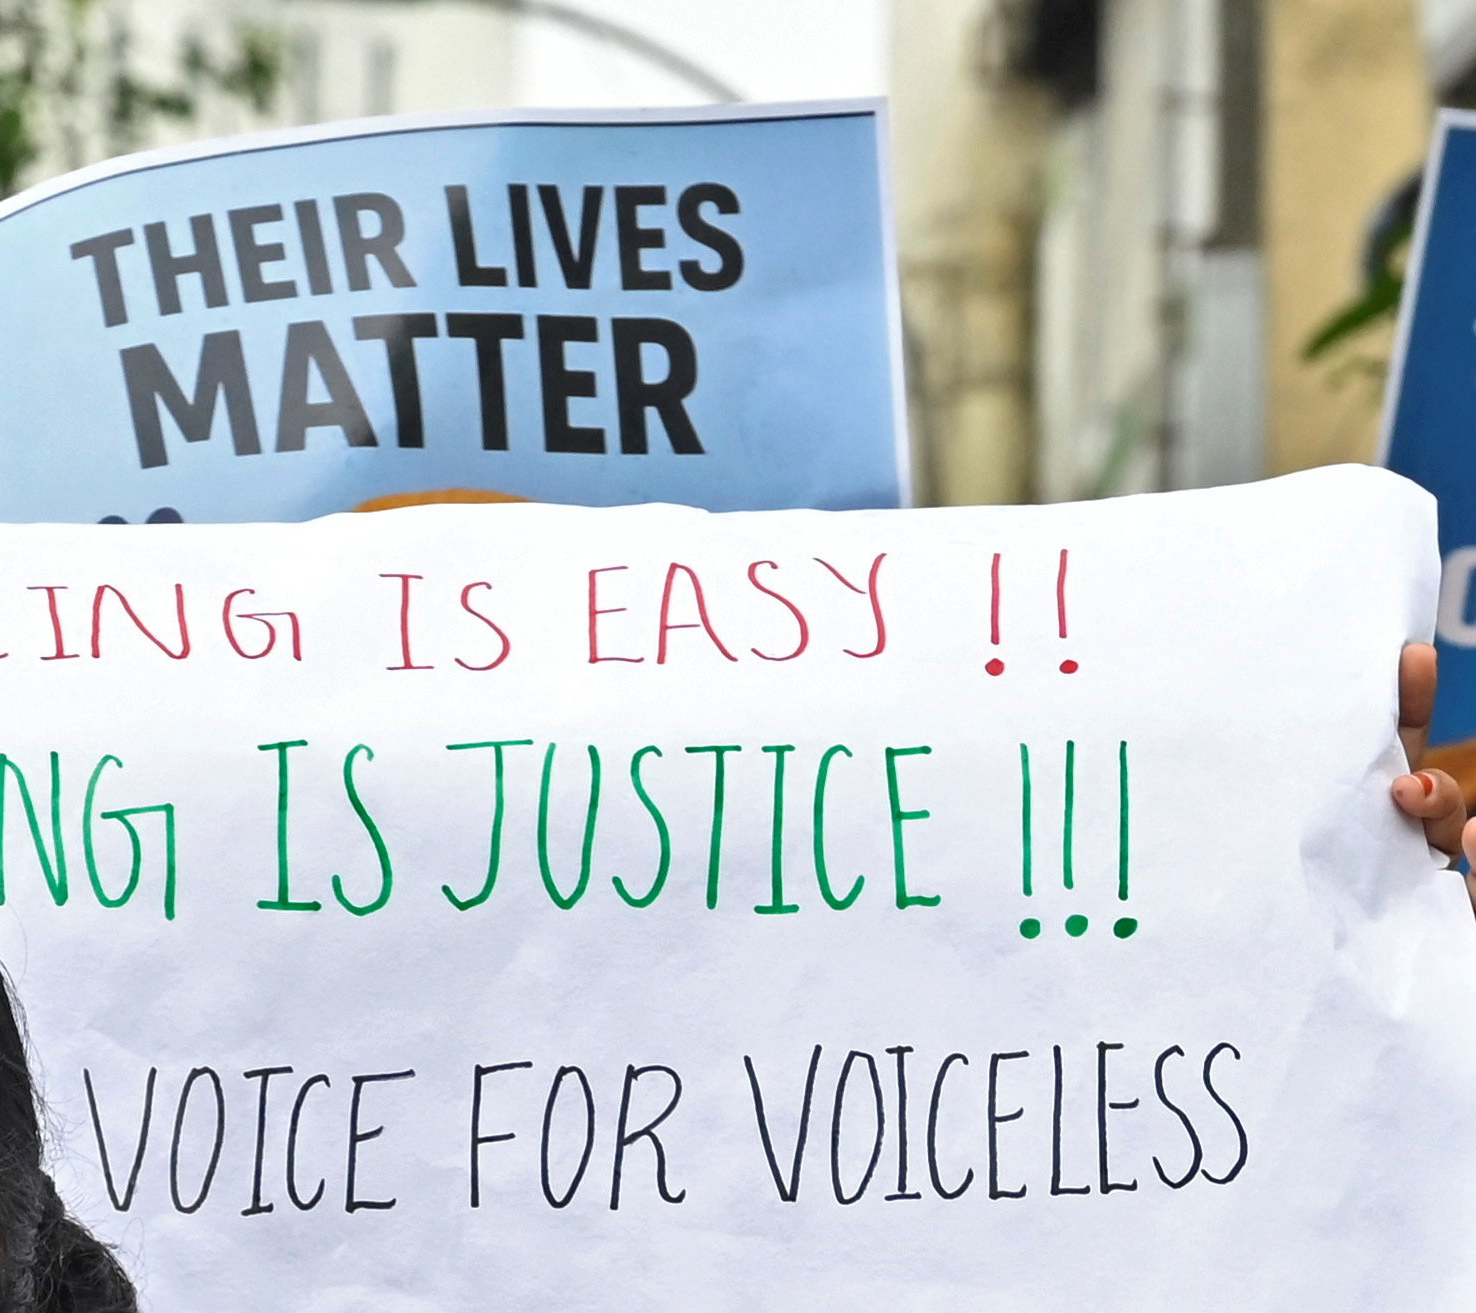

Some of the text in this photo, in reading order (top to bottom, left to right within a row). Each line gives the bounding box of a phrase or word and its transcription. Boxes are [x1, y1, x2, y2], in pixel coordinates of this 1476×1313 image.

[69, 181, 745, 327] THEIR LIVES
[118, 311, 707, 469] MATTER
[387, 568, 513, 671] IS
[587, 549, 891, 668] EASY
[254, 738, 395, 918] IS
[440, 738, 943, 922] JUSTICE
[83, 1039, 1248, 1219] VOICE FOR VOICELESS
